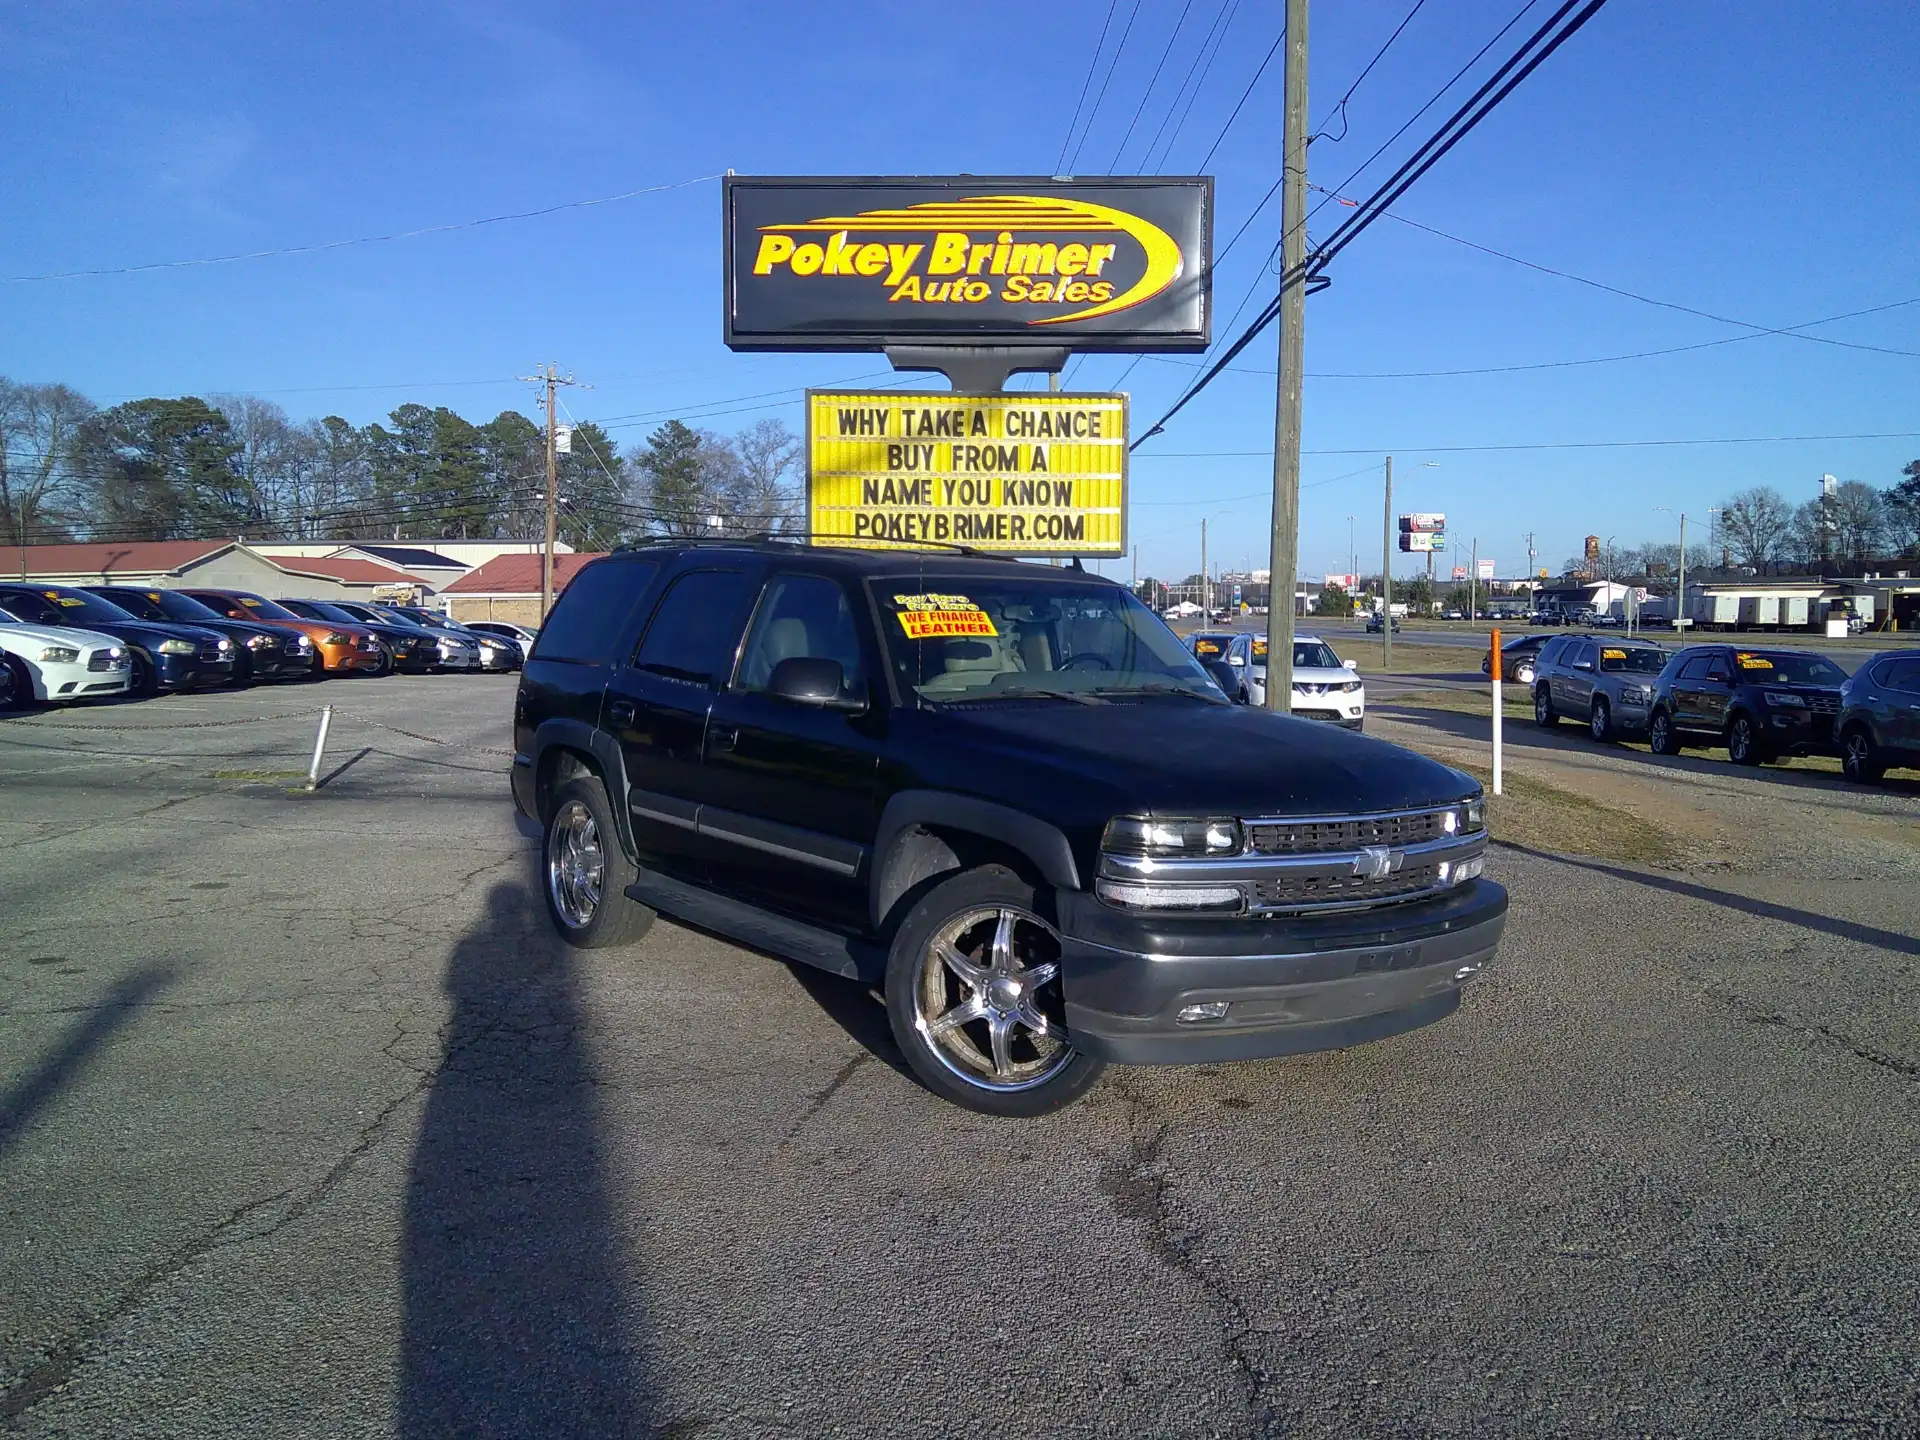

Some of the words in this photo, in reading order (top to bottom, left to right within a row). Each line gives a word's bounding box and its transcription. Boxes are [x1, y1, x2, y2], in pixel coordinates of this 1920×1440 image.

[753, 230, 925, 287] Pokey
[927, 231, 1116, 276] Brimer
[888, 275, 991, 303] Auto
[1001, 275, 1116, 303] Sales
[838, 409, 889, 436] WHY
[902, 409, 965, 437] TAKE
[971, 410, 988, 437] A
[1005, 410, 1101, 438] CHANCE
[888, 444, 934, 471] BUY
[952, 444, 1019, 472] FROM
[1031, 446, 1048, 472] A
[863, 478, 932, 506] NAME
[943, 479, 991, 506] YOU
[1003, 480, 1072, 507] KNOW
[855, 513, 1084, 541] POKEYBRIMER.COM
[904, 612, 925, 623] WE
[929, 611, 985, 622] FINANCE
[910, 623, 991, 635] LEATHER
